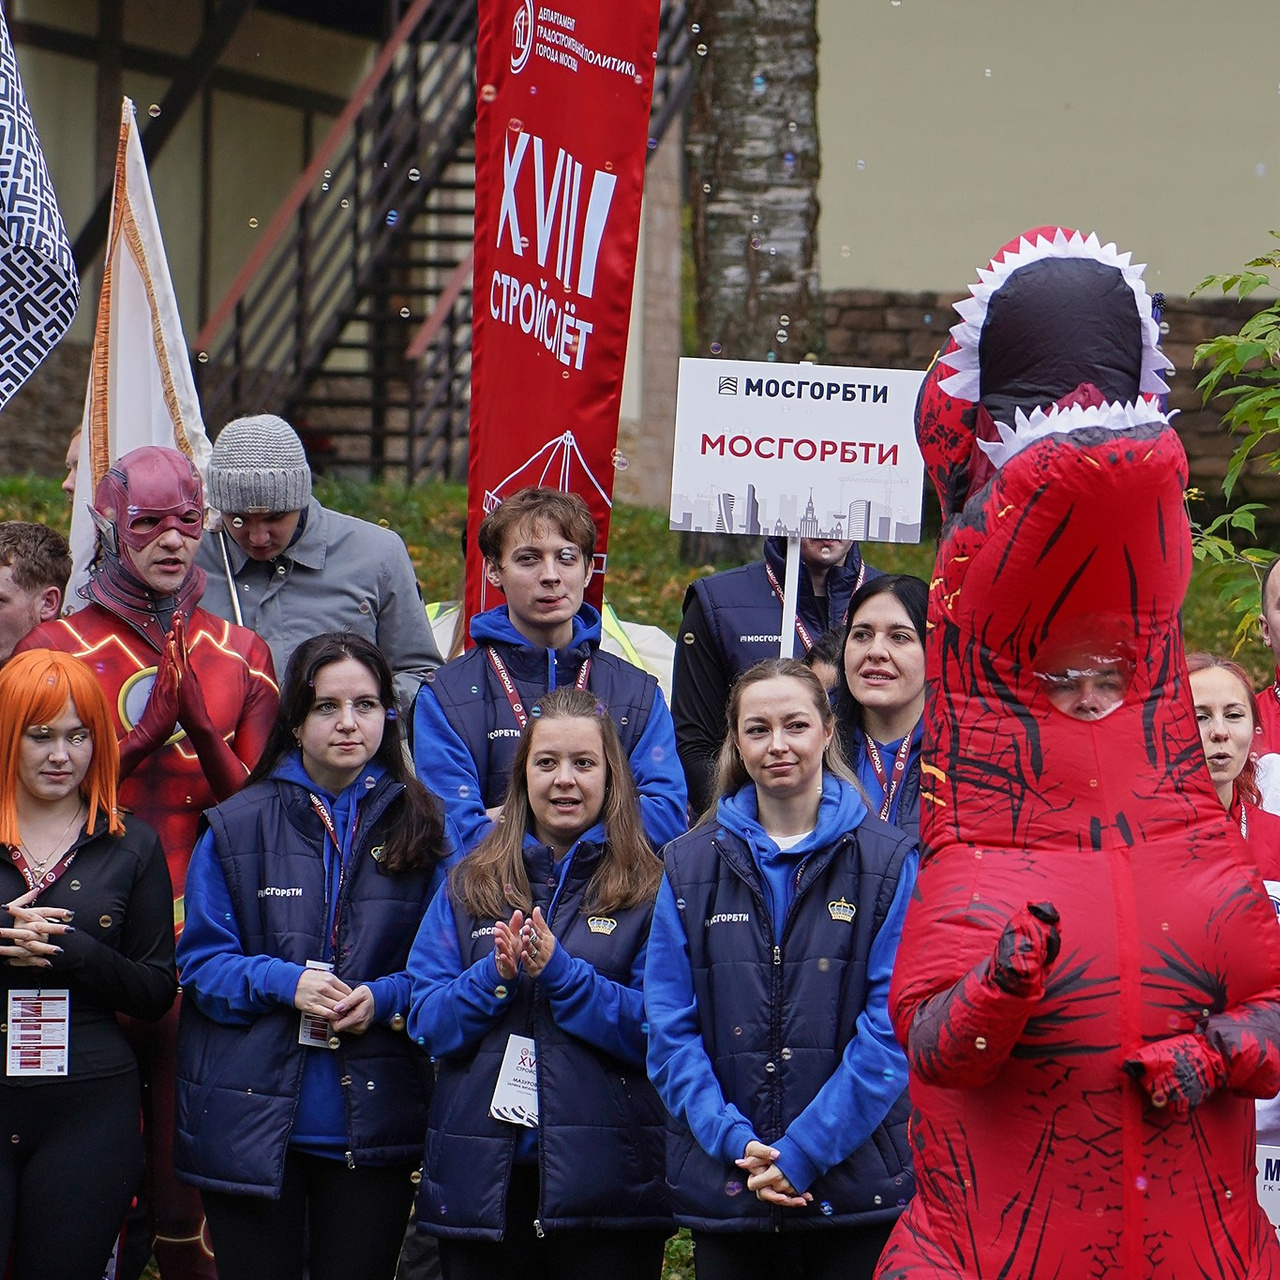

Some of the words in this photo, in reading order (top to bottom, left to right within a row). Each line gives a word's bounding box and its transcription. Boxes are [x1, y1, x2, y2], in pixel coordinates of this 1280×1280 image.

[538, 7, 576, 31] ДЕПАРТАМЕНТ
[536, 42, 559, 63] ГОРОДА
[584, 48, 636, 77] ПОЛИТИКИ
[490, 270, 593, 370] СТРОЙСЛЁТ
[745, 378, 888, 404] МОСГОРБТИ
[701, 433, 899, 466] МОСГОРБТИ
[1263, 1184, 1274, 1192] ГК
